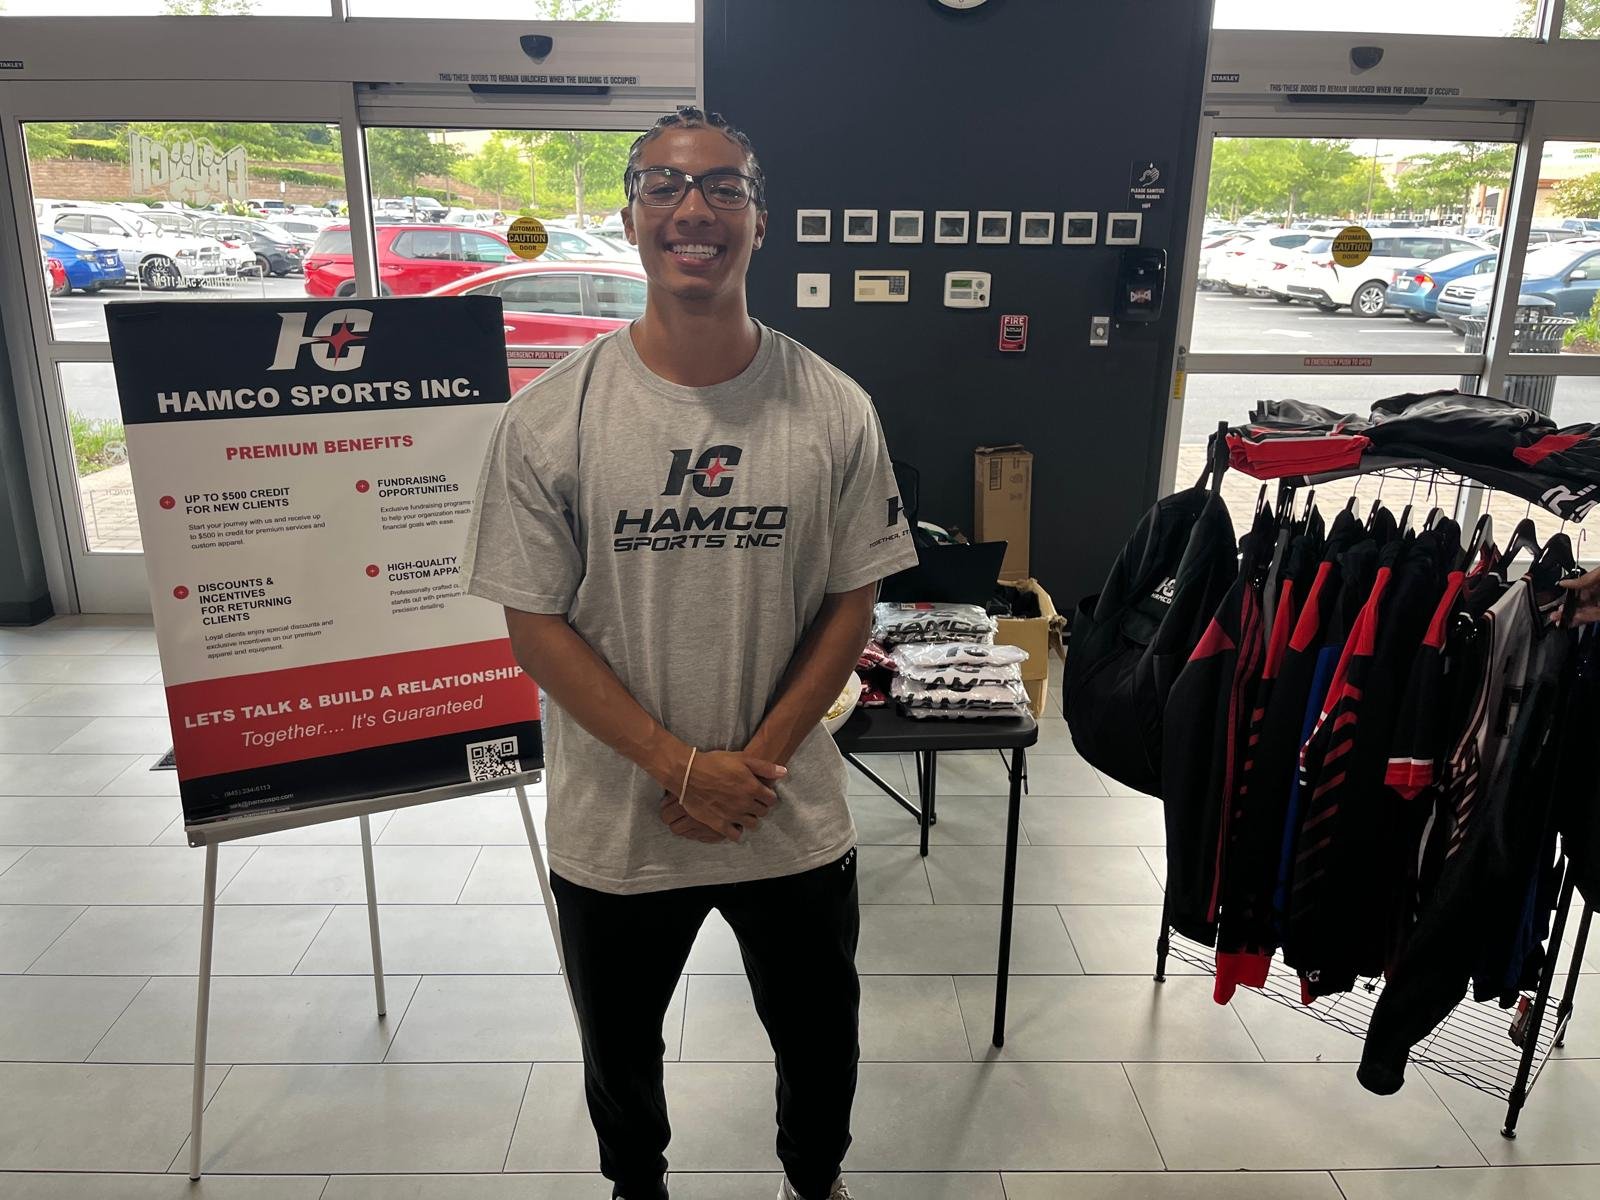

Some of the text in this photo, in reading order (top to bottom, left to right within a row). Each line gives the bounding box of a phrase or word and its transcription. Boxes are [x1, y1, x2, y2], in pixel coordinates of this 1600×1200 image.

[471, 74, 489, 82] DOORS
[520, 75, 548, 83] UNLOCKED
[549, 75, 564, 83] WHEN
[578, 76, 602, 84] BUILDING
[610, 76, 637, 85] OCCUPIED
[1300, 84, 1318, 92] DOORS
[1327, 85, 1347, 93] REMAIN
[1348, 85, 1375, 93] UNLOCKED
[1376, 86, 1391, 94] WHEN
[1393, 86, 1402, 94] THE
[1403, 87, 1427, 95] BUILDING
[1428, 87, 1433, 95] IS
[1434, 87, 1460, 95] OCCUPIED
[509, 234, 546, 242] CAUTION
[1333, 243, 1370, 251] CAUTION
[1005, 316, 1025, 325] FIRE
[507, 351, 534, 359] EMERGENCY
[535, 351, 548, 359] PUSH
[157, 377, 480, 414] HAMCO SPORTS INC.
[226, 435, 414, 461] PREMIUM BENEFITS
[377, 474, 446, 487] FUNDRAISING
[185, 487, 290, 504] UP TO $500 CREDIT
[378, 483, 459, 498] OPPORTUNITIES
[186, 498, 289, 515] FOR NEW CLIENTS
[380, 505, 410, 513] Exclusive
[410, 501, 442, 510] fundraising
[443, 500, 471, 508] programs
[188, 523, 205, 531] Start
[206, 522, 222, 531] your
[223, 520, 248, 530] journey
[249, 518, 263, 526] with
[288, 514, 311, 522] receive
[388, 513, 402, 522] help
[403, 513, 417, 521] your
[417, 509, 454, 519] organization
[614, 506, 788, 534] HAMCO
[198, 532, 216, 540] $500
[225, 529, 244, 537] credit
[245, 527, 254, 535] for
[255, 526, 285, 535] premium
[285, 523, 312, 532] services
[313, 521, 326, 529] and
[382, 522, 407, 531] financial
[408, 520, 425, 529] goals
[191, 539, 245, 550] custom apparel.
[614, 533, 783, 551] SPORTS INC
[387, 556, 457, 572] HIGH-QUALITY
[388, 566, 461, 582] CUSTOM APPA
[198, 577, 274, 593] DISCOUNTS &
[390, 587, 431, 597] Professionally
[432, 584, 453, 593] crafted
[199, 588, 266, 605] INCENTIVES
[391, 598, 411, 606] stands
[436, 592, 461, 600] premium
[201, 596, 292, 615] FOR RETURNING
[392, 606, 419, 615] precision
[202, 612, 250, 626] CLIENTS
[205, 619, 334, 642] Loyal clients enjoy special discounts and
[206, 641, 238, 650] exclusive
[238, 637, 271, 646] incentives
[294, 630, 322, 639] premium
[207, 650, 233, 660] apparel
[248, 644, 284, 654] equipment.
[184, 665, 524, 729] LETS TALK & BUILD A RELATIONSHIP
[241, 694, 484, 747] Together.... It's Guaranteed
